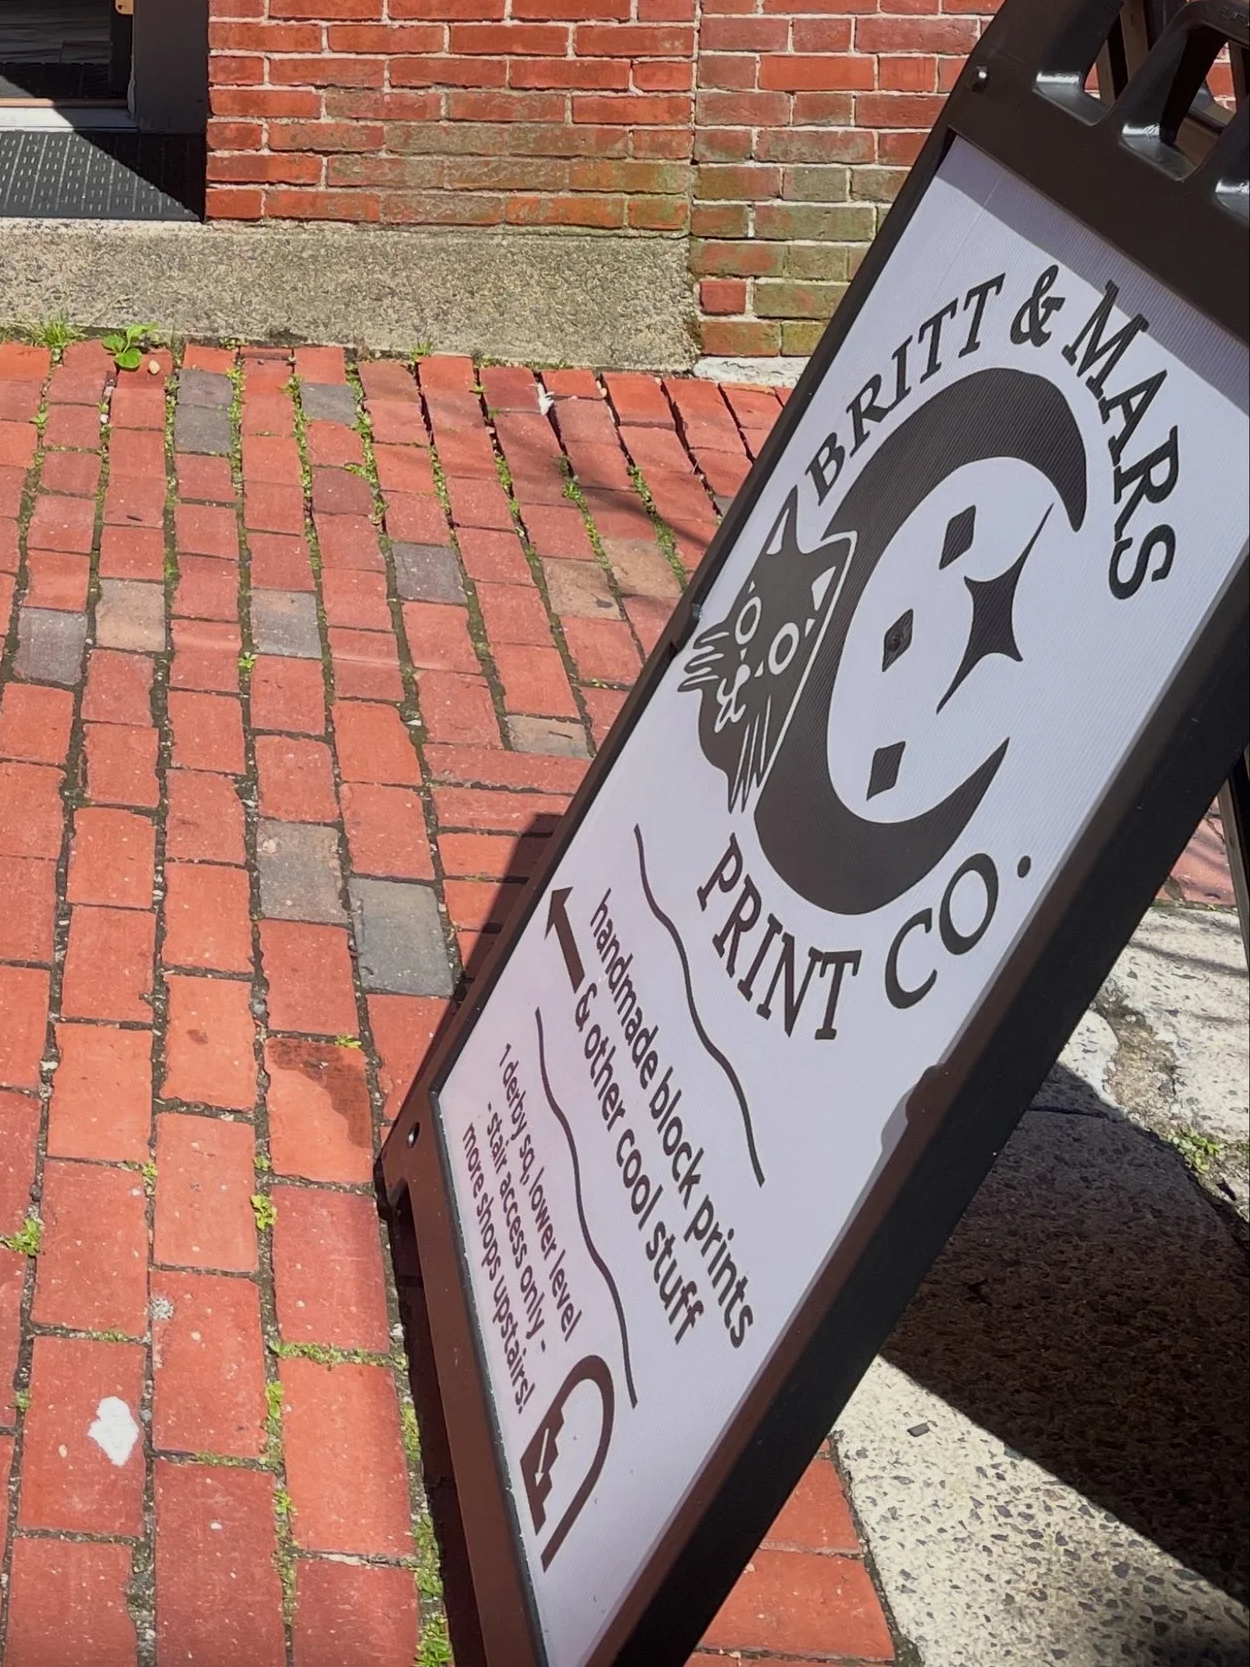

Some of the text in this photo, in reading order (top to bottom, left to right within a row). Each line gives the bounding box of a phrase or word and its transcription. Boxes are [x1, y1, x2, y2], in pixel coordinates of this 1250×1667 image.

[804, 264, 1180, 601] BRITT & MARS
[696, 831, 1032, 1041] PRINT CO.
[499, 1043, 511, 1067] 1
[502, 1060, 527, 1141] derby
[575, 982, 705, 1345] & other cool stuff
[590, 887, 754, 1349] handmade block prints
[462, 1122, 536, 1415] more shops upstairs!
[486, 1111, 509, 1174] stair
[499, 1171, 528, 1269] access
[520, 1264, 546, 1341] only
[528, 1166, 557, 1261] lower
[548, 1249, 582, 1343] level
